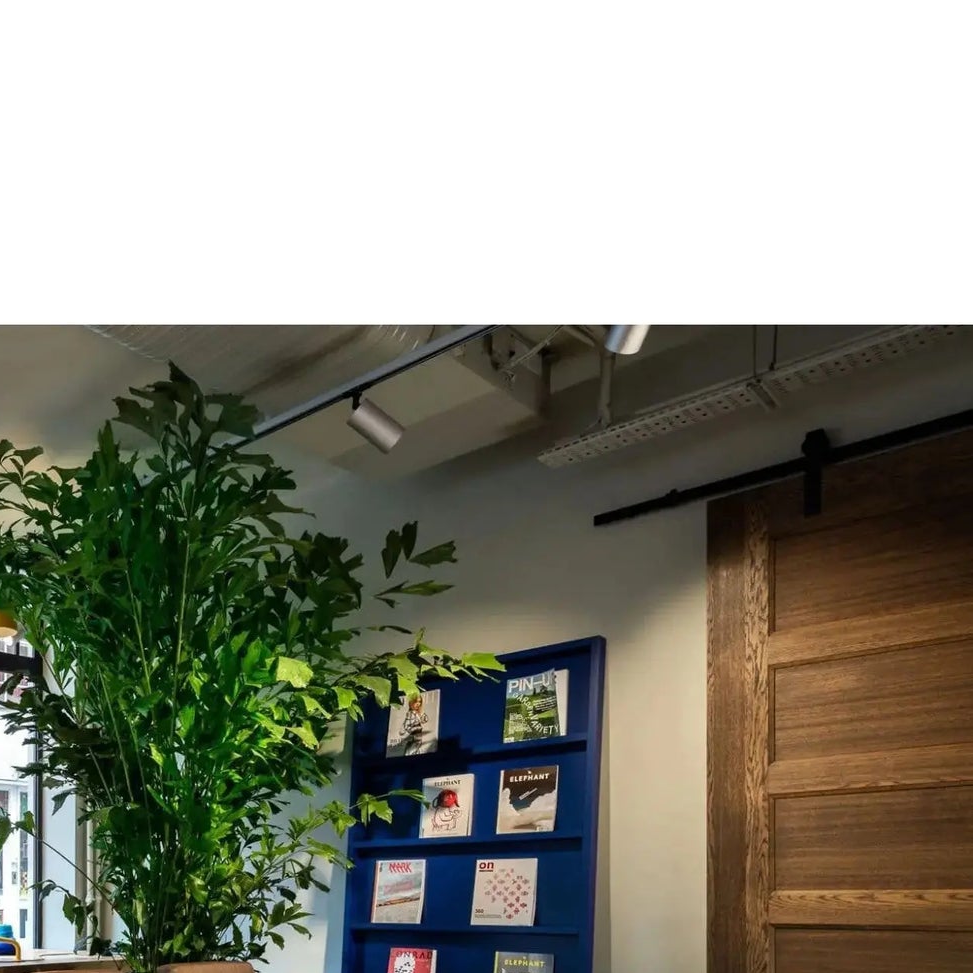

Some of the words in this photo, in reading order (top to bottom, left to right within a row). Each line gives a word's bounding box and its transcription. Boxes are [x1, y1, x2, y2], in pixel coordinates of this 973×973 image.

[509, 772, 550, 783] ELEPHANT
[434, 779, 461, 787] ELEPHANT
[389, 862, 412, 873] MARK
[479, 861, 495, 870] on
[504, 959, 546, 968] ELEPHANT
